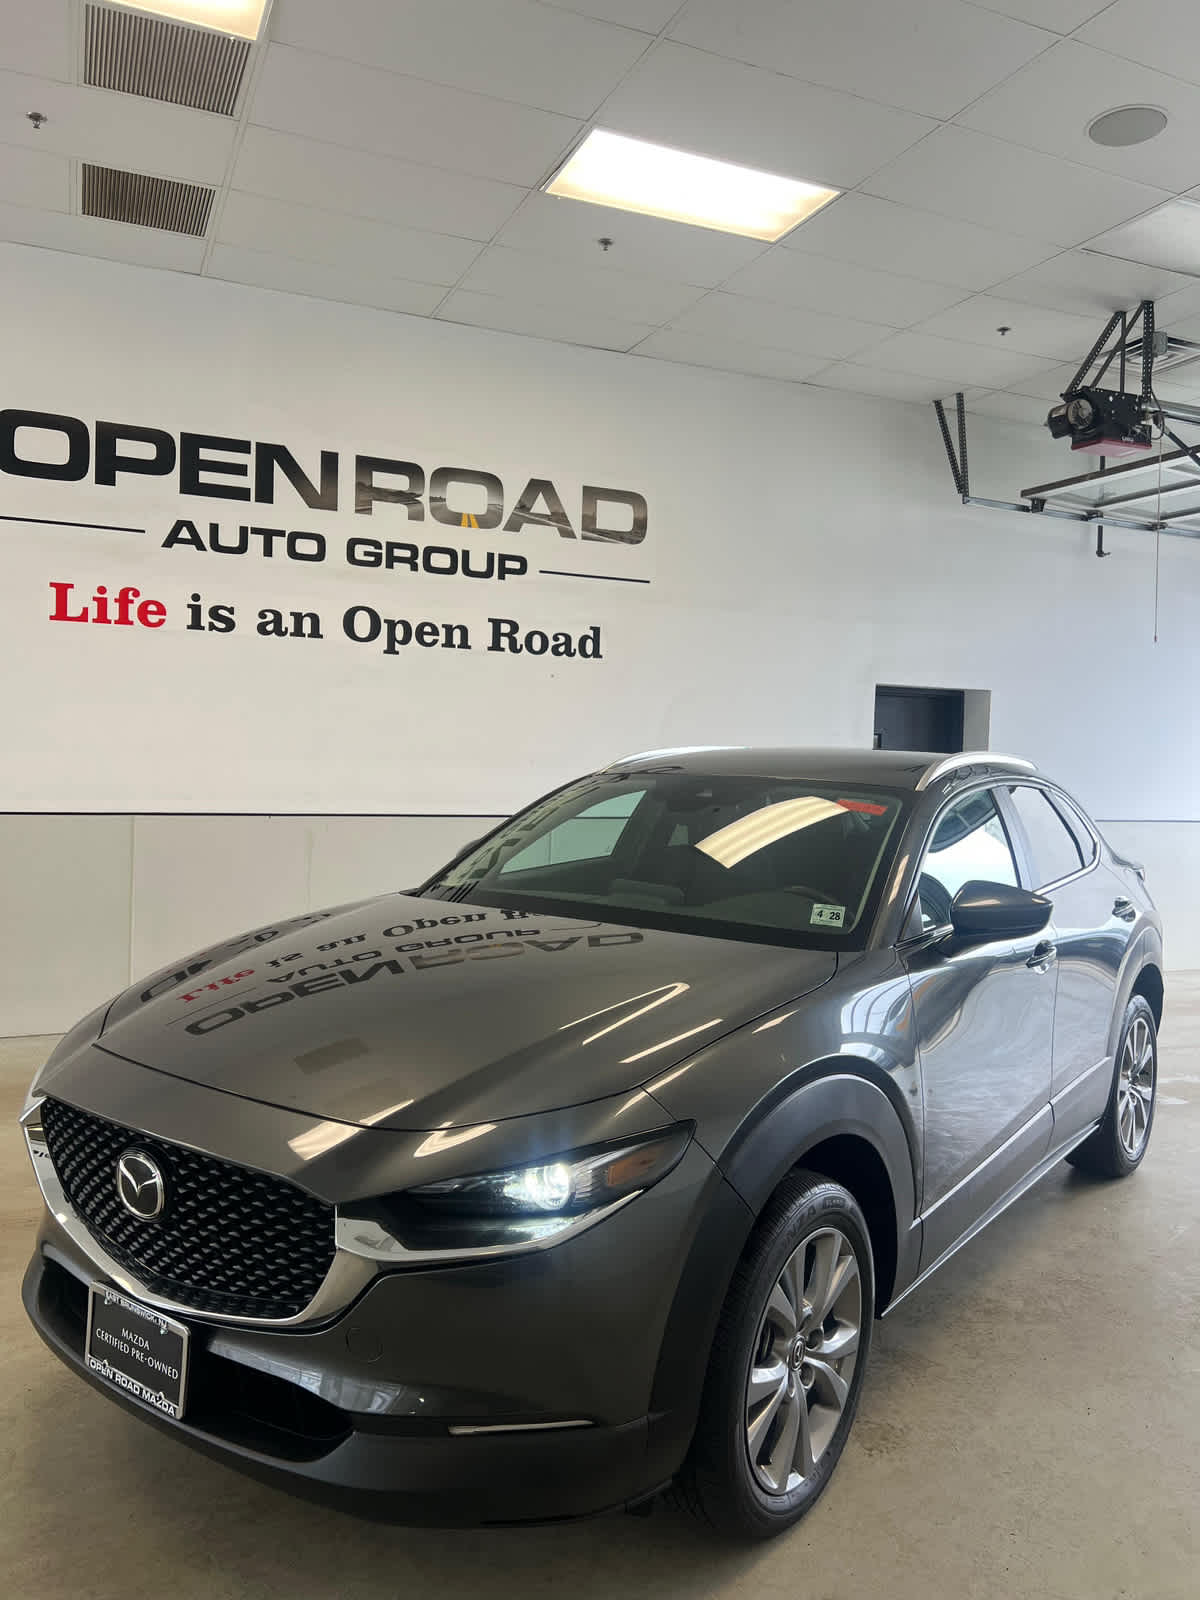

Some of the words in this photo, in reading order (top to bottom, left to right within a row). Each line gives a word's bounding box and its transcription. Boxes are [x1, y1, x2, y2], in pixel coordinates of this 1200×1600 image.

[0, 408, 339, 513] OPEN
[354, 454, 649, 545] ROAD
[161, 519, 327, 563] AUTO
[346, 537, 529, 580] GROUP
[49, 581, 167, 629] Life
[186, 593, 236, 633] is
[256, 606, 323, 639] an
[342, 605, 472, 655] Open
[487, 618, 604, 659] Road
[817, 910, 823, 918] 4
[829, 911, 841, 921] 28
[95, 1328, 130, 1354] CERTIFIED
[131, 1349, 179, 1380] PRE-OWNED
[121, 1327, 150, 1350] MAZDA
[90, 1360, 113, 1380] OPEN
[114, 1373, 141, 1395] ROAD
[141, 1389, 176, 1417] MAZDA
